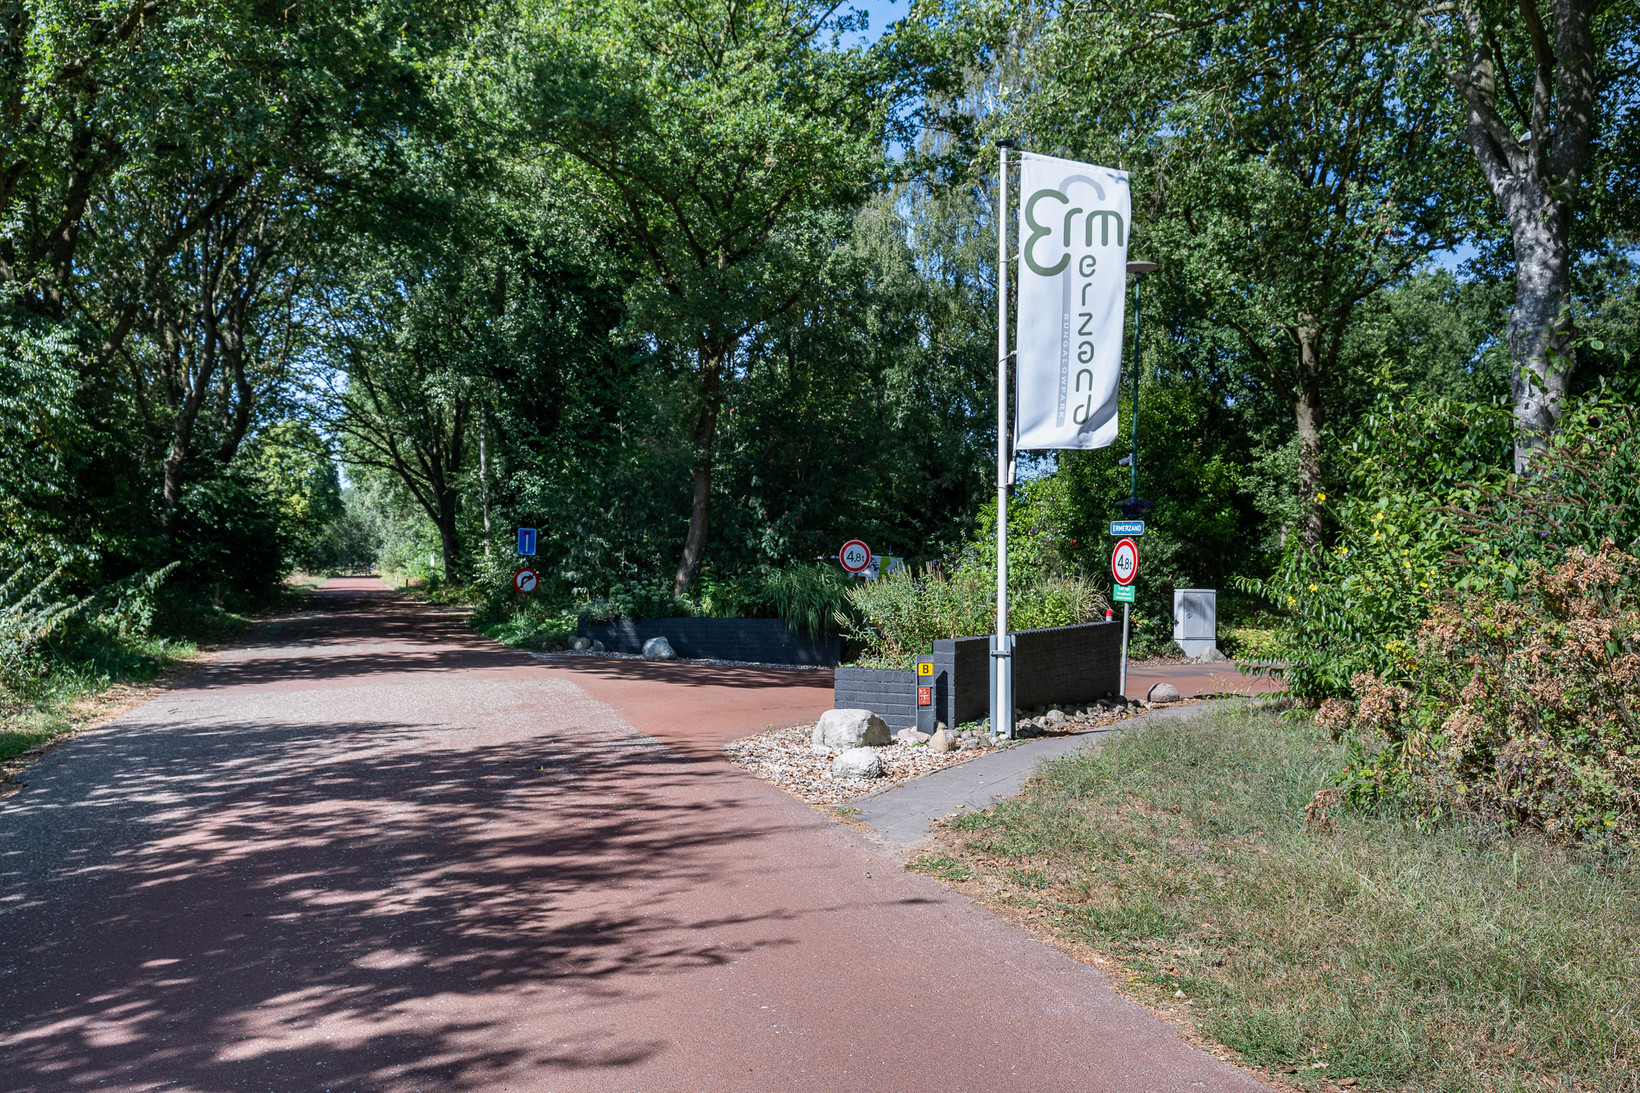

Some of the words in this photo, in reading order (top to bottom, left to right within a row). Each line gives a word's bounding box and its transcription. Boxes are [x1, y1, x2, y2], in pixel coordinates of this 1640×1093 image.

[1058, 313, 1070, 419] BUNGALOWPARK
[1112, 524, 1142, 532] ERMERZAND
[922, 664, 930, 674] B
